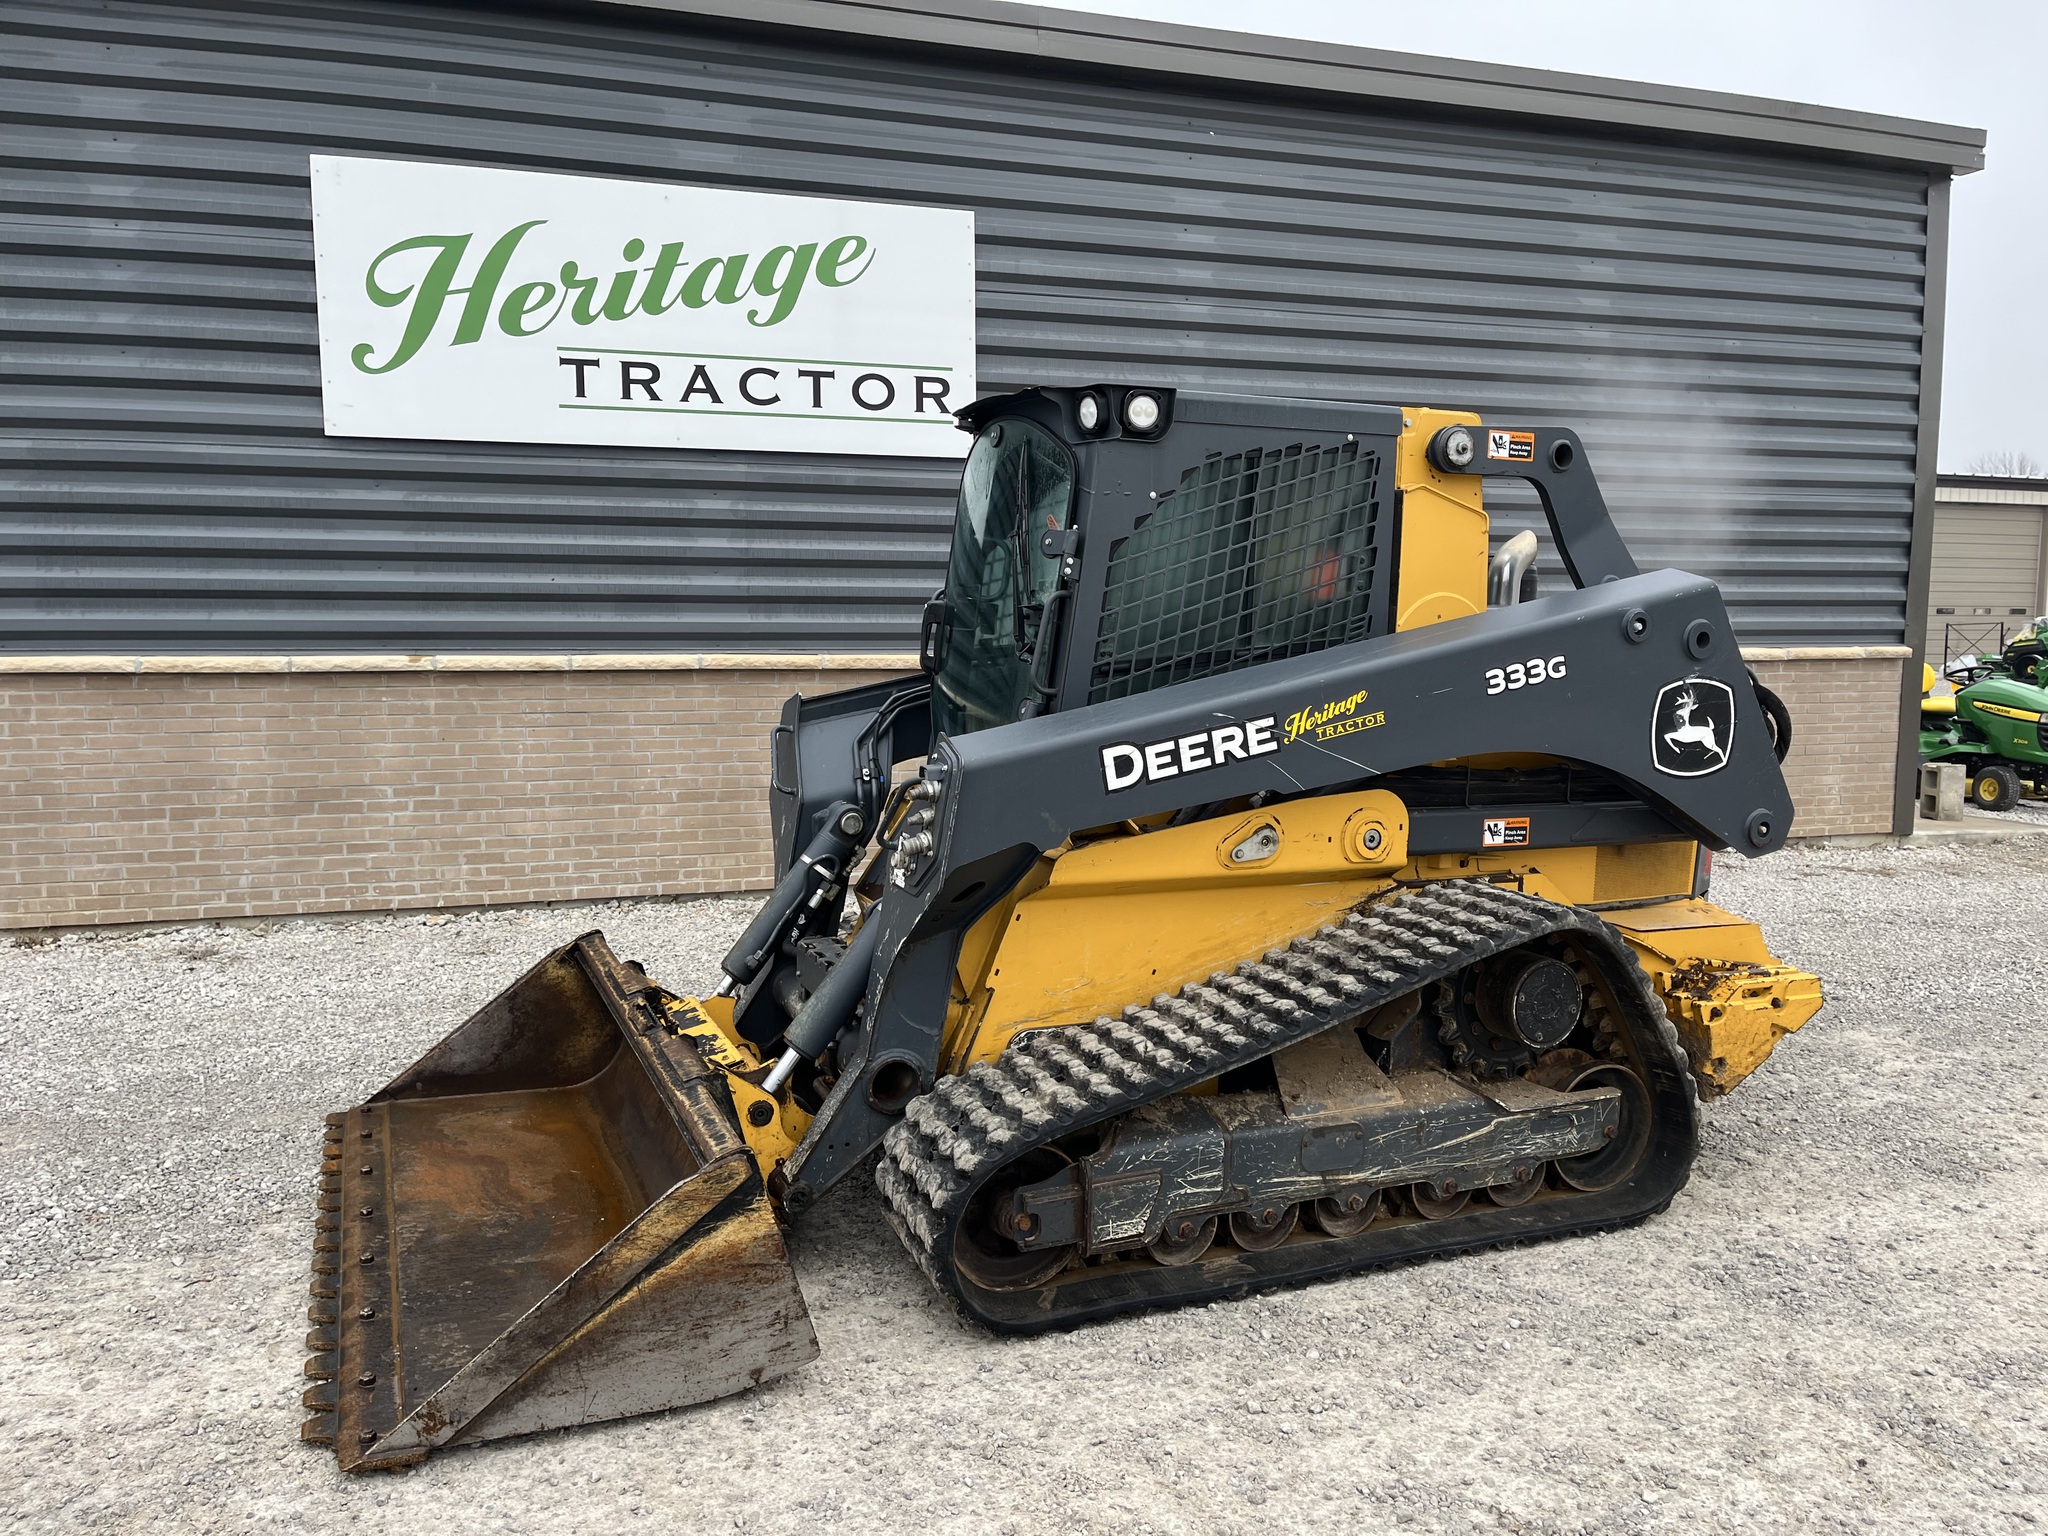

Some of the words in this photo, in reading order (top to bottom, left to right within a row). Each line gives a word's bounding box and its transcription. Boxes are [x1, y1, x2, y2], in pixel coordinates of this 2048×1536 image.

[351, 219, 877, 375] Heritage
[558, 356, 951, 414] TRACTOR
[1484, 654, 1567, 695] 333G
[1283, 689, 1369, 745] Heritage
[1315, 713, 1385, 739] TRACTOR
[1993, 706, 2012, 715] DEERE
[1101, 715, 1279, 792] DEERE
